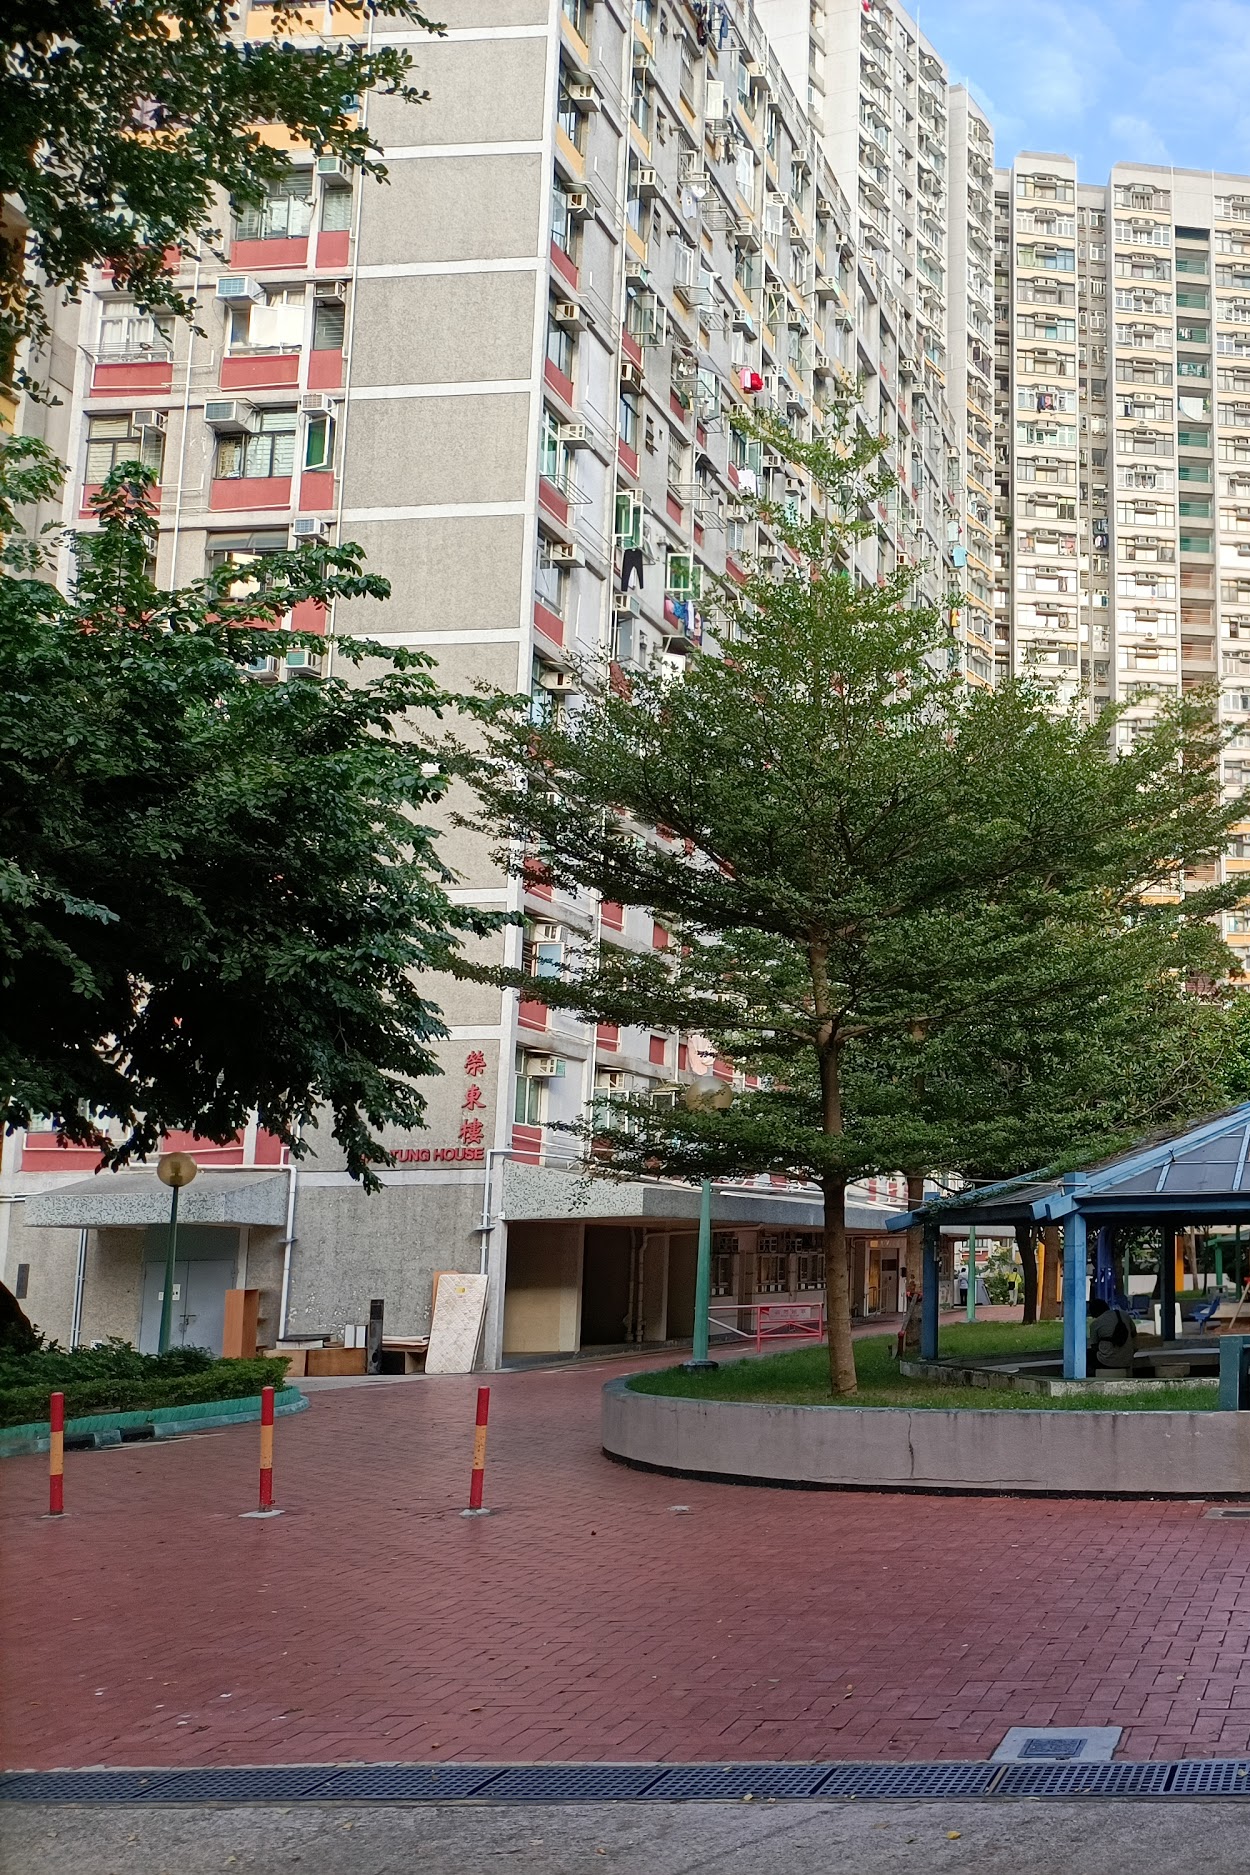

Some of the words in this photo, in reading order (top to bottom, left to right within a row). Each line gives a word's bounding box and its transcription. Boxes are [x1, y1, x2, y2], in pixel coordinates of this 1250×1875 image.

[458, 1050, 487, 1147] 榮東樓
[433, 1147, 485, 1162] HOUSE
